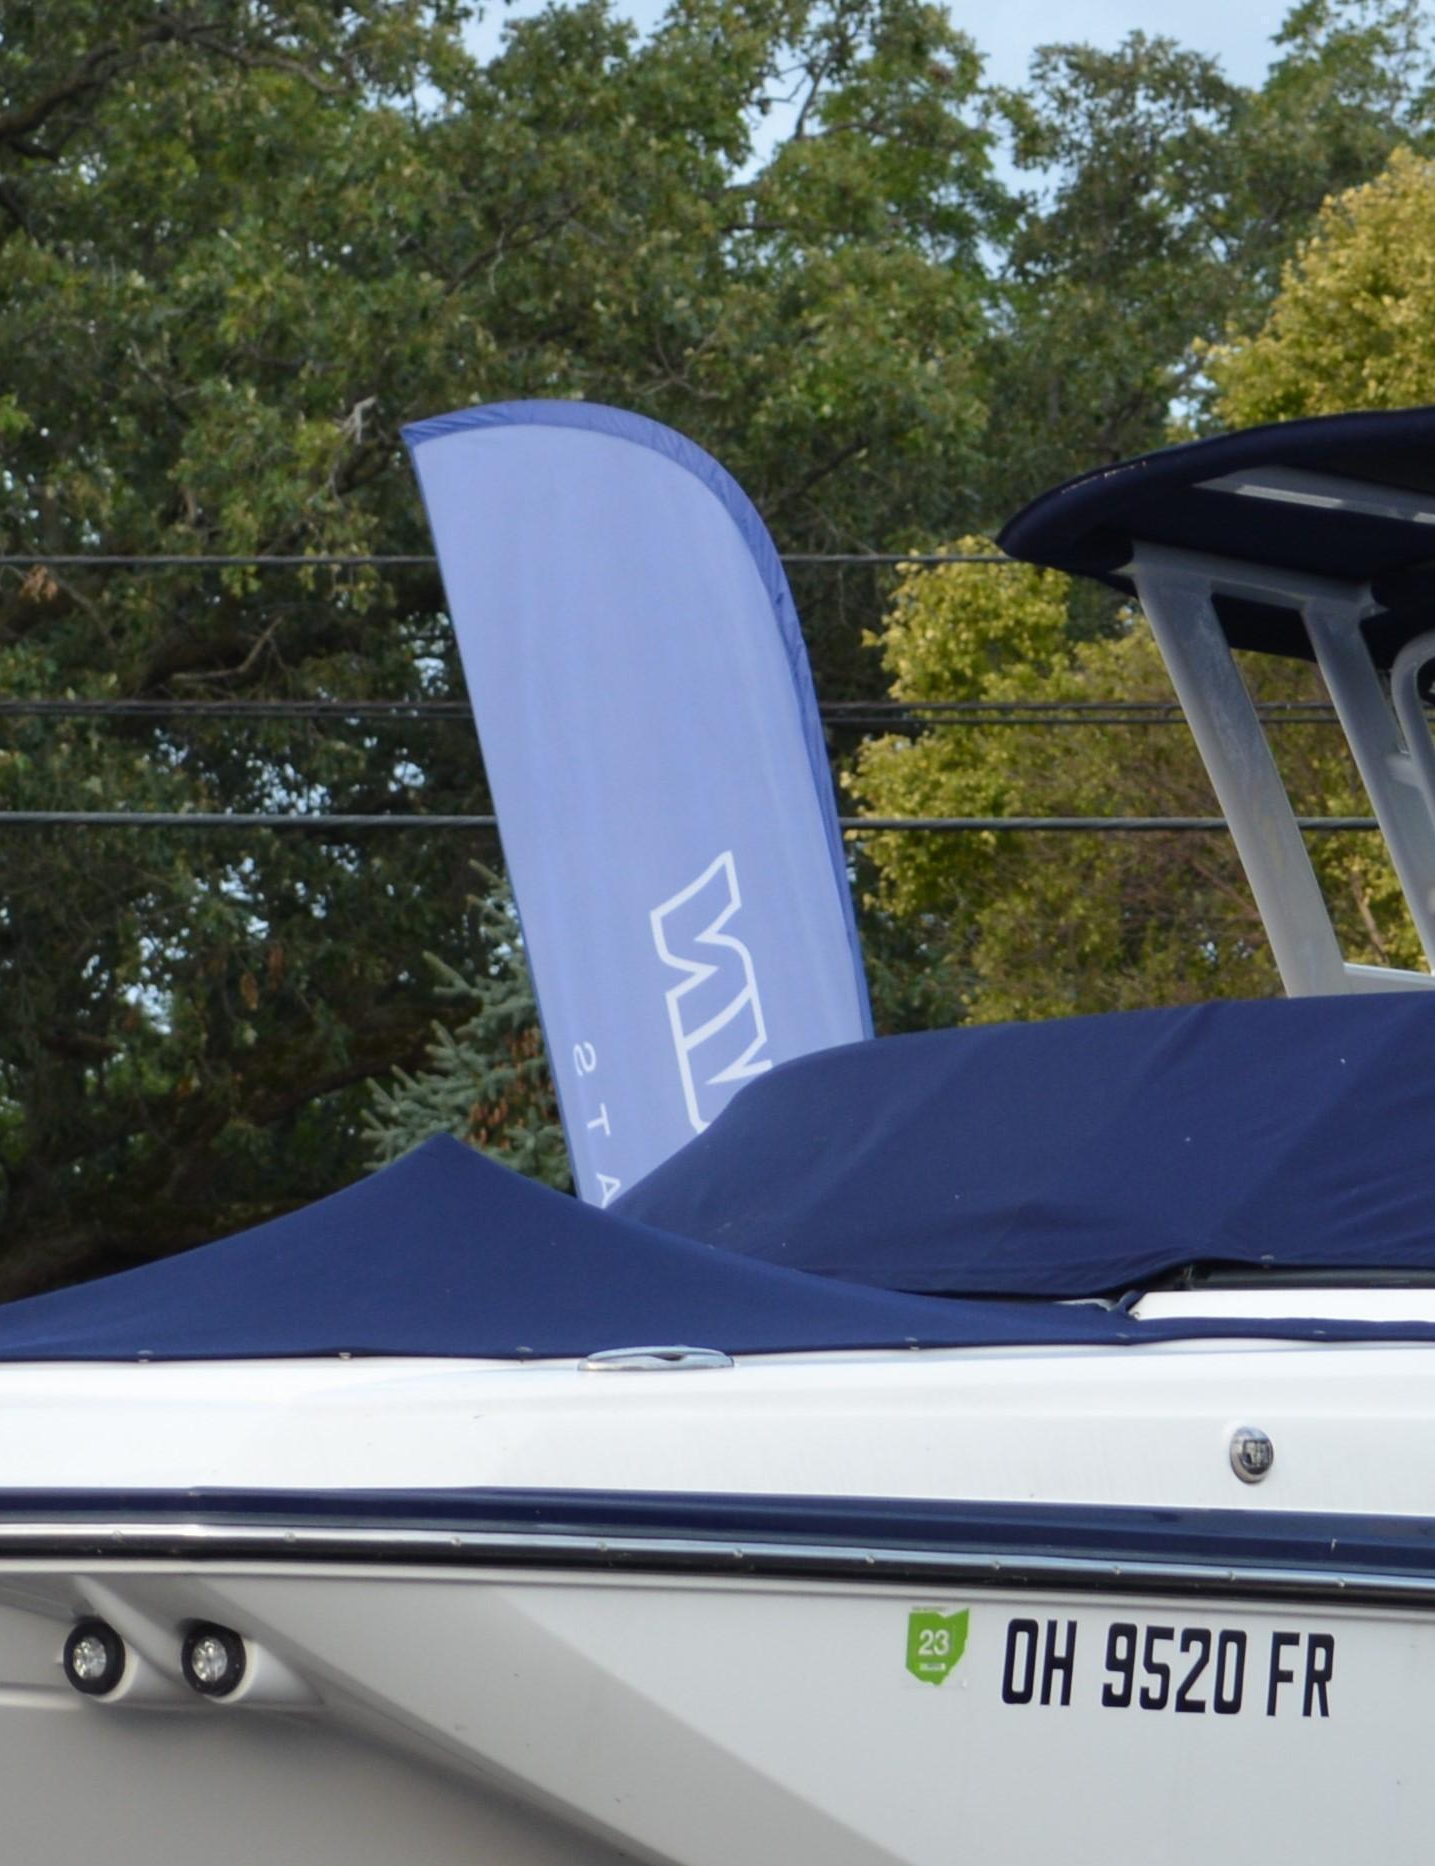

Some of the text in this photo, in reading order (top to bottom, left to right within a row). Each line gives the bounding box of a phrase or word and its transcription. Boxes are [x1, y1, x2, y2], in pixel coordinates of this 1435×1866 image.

[918, 1629, 949, 1655] 23
[1001, 1618, 1335, 1717] OH 9520 FR
